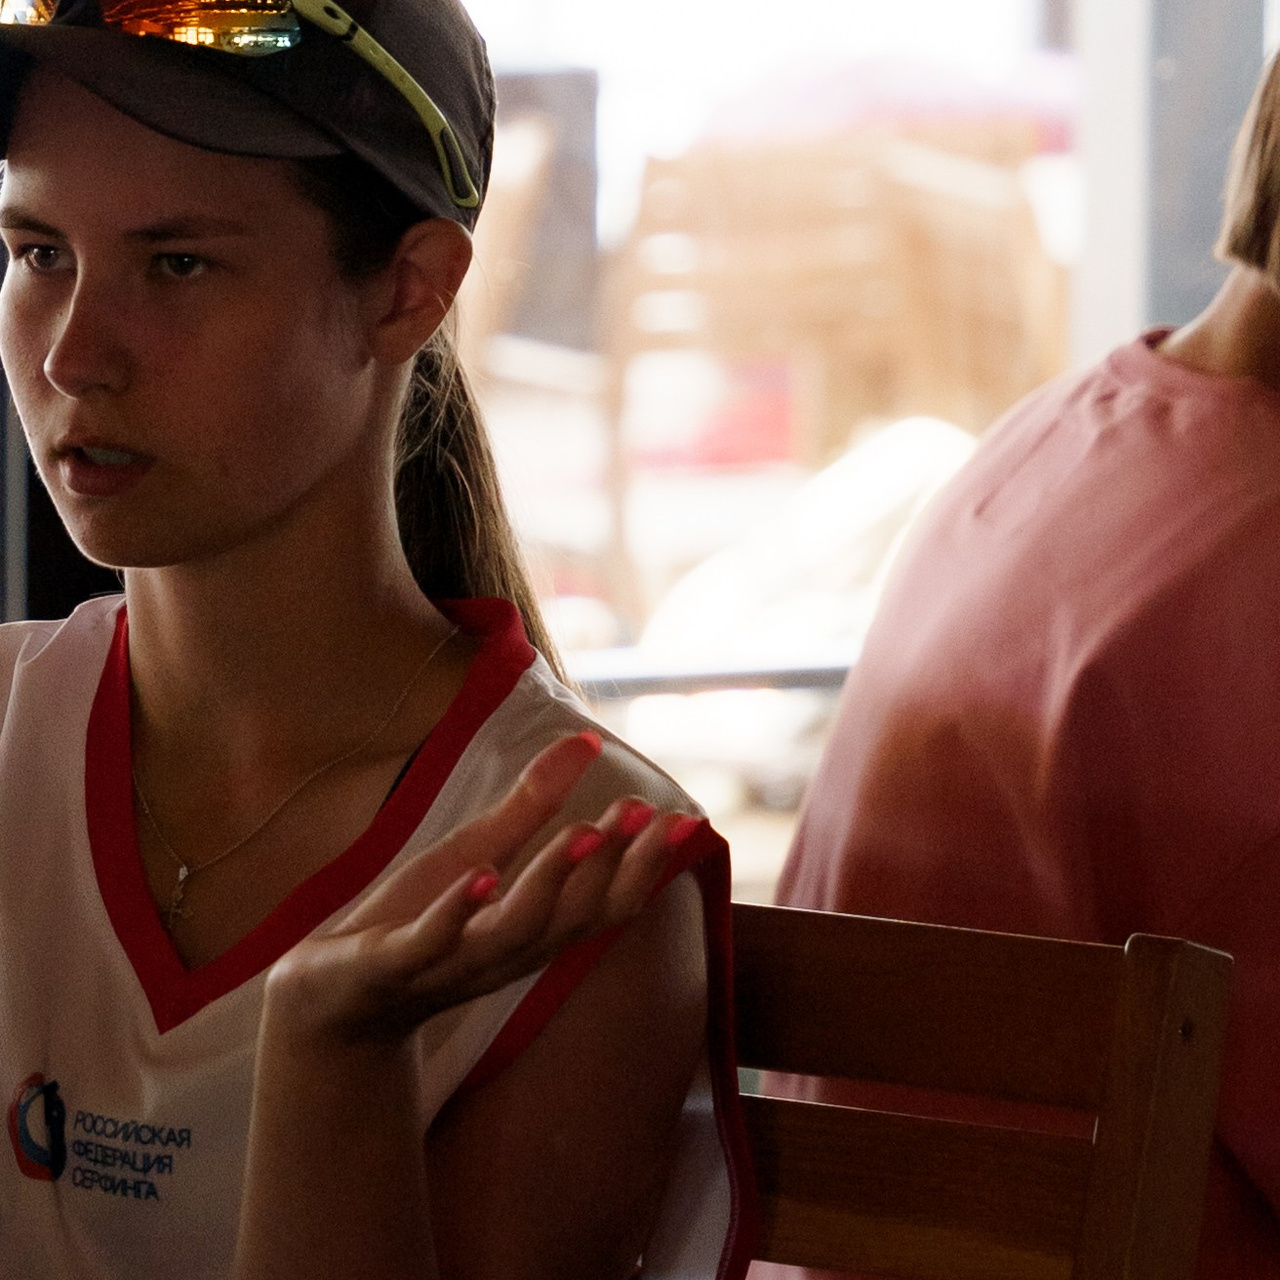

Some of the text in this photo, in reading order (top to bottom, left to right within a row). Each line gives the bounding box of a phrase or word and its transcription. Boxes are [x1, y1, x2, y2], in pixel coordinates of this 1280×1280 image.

[73, 1110, 191, 1148] РОССИЙСКАЯ
[72, 1140, 172, 1176] ФЕДЕРАЦИЯ
[72, 1166, 159, 1201] СЕРФИНГА
